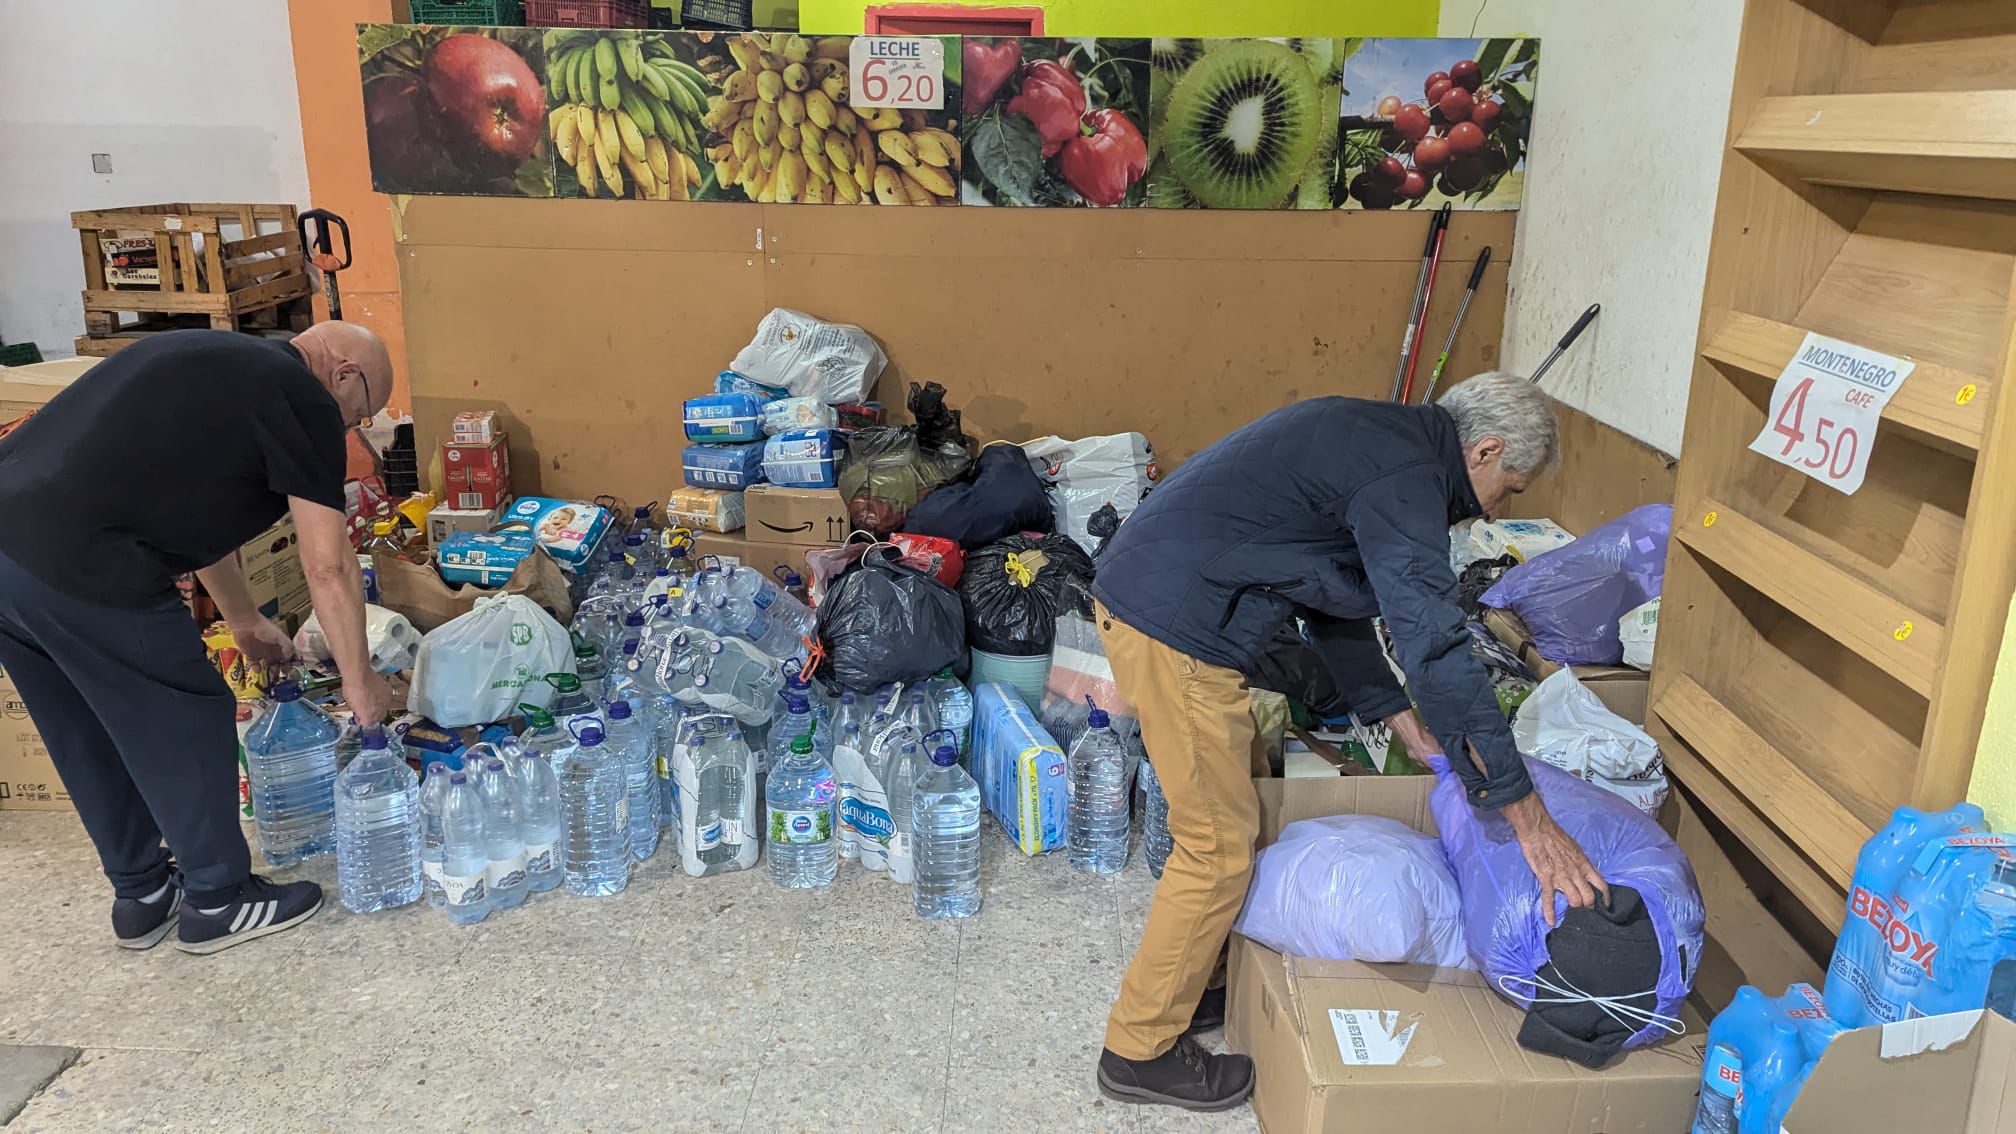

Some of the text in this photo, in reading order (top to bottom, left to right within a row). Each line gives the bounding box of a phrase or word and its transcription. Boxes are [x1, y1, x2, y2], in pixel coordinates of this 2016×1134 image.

[870, 41, 920, 56] LECHE
[862, 60, 934, 104] 6,20
[1802, 346, 1896, 388] MONTENEGRO
[1845, 389, 1875, 408] CAFE
[1773, 377, 1858, 480] 4,50
[511, 624, 530, 643] SPB
[491, 674, 547, 689] MERCAON
[842, 804, 893, 834] aquaBona
